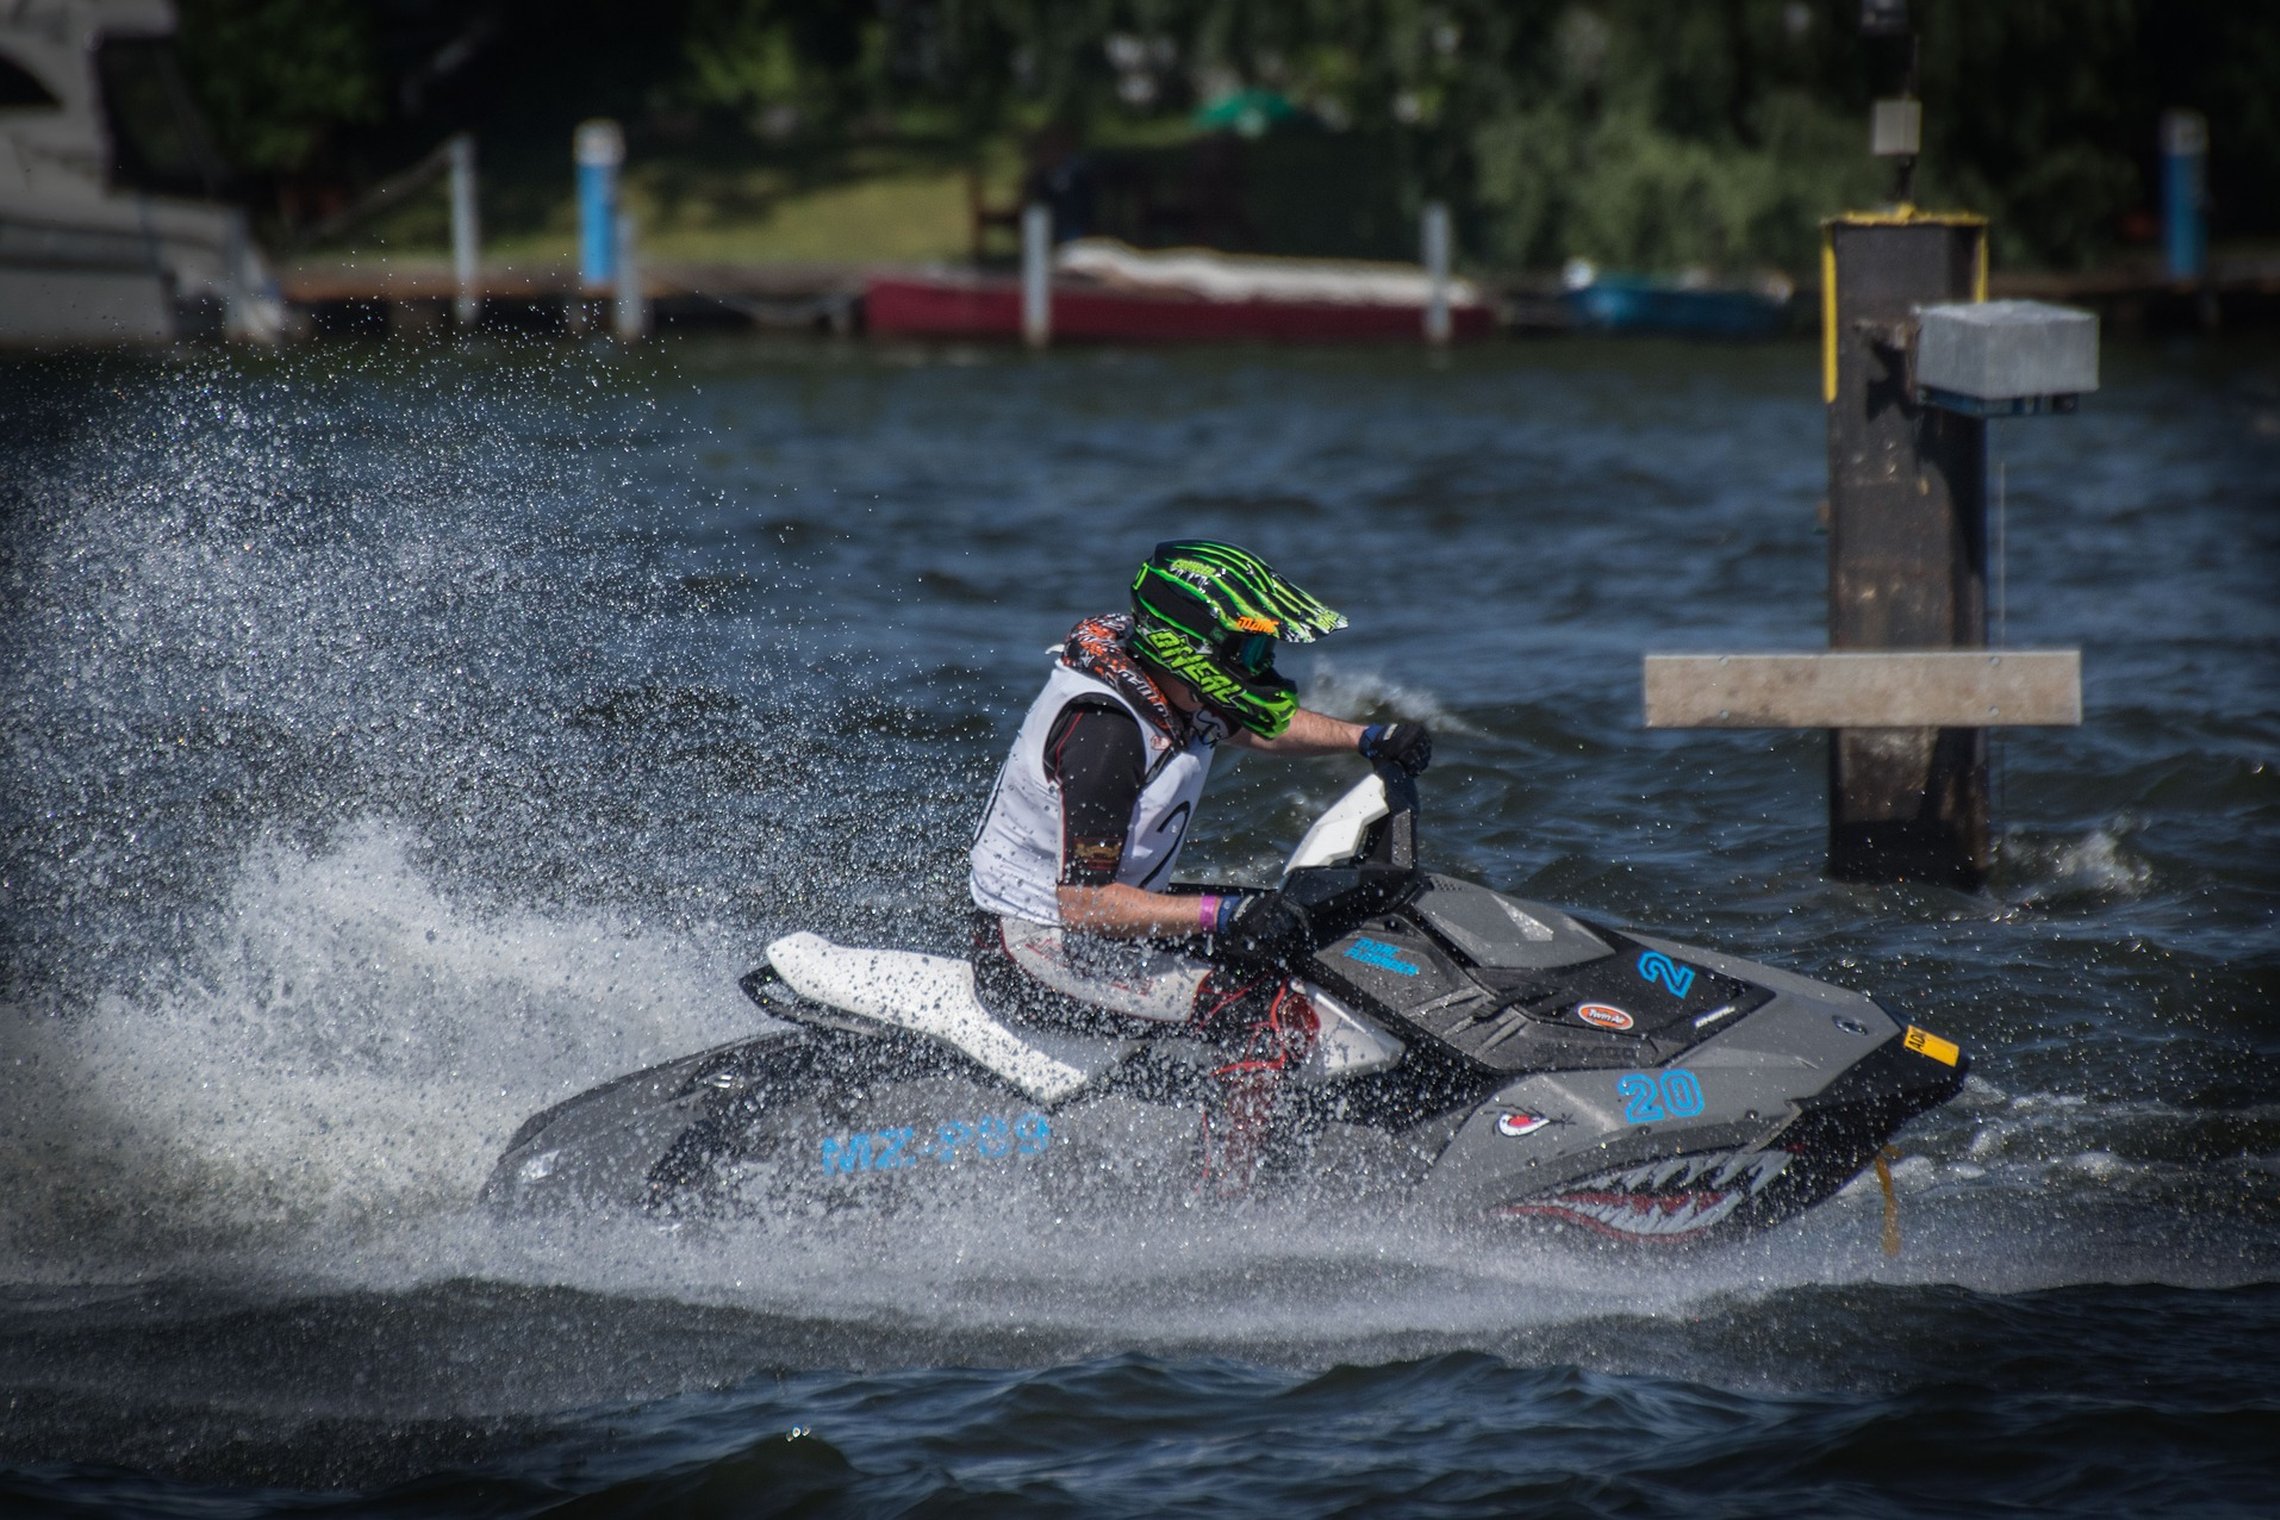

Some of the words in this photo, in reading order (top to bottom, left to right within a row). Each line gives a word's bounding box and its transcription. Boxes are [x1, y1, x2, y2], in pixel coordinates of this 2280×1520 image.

[1637, 951, 1697, 999] 2
[1589, 1008, 1611, 1022] Twin
[1616, 1067, 1706, 1125] 20
